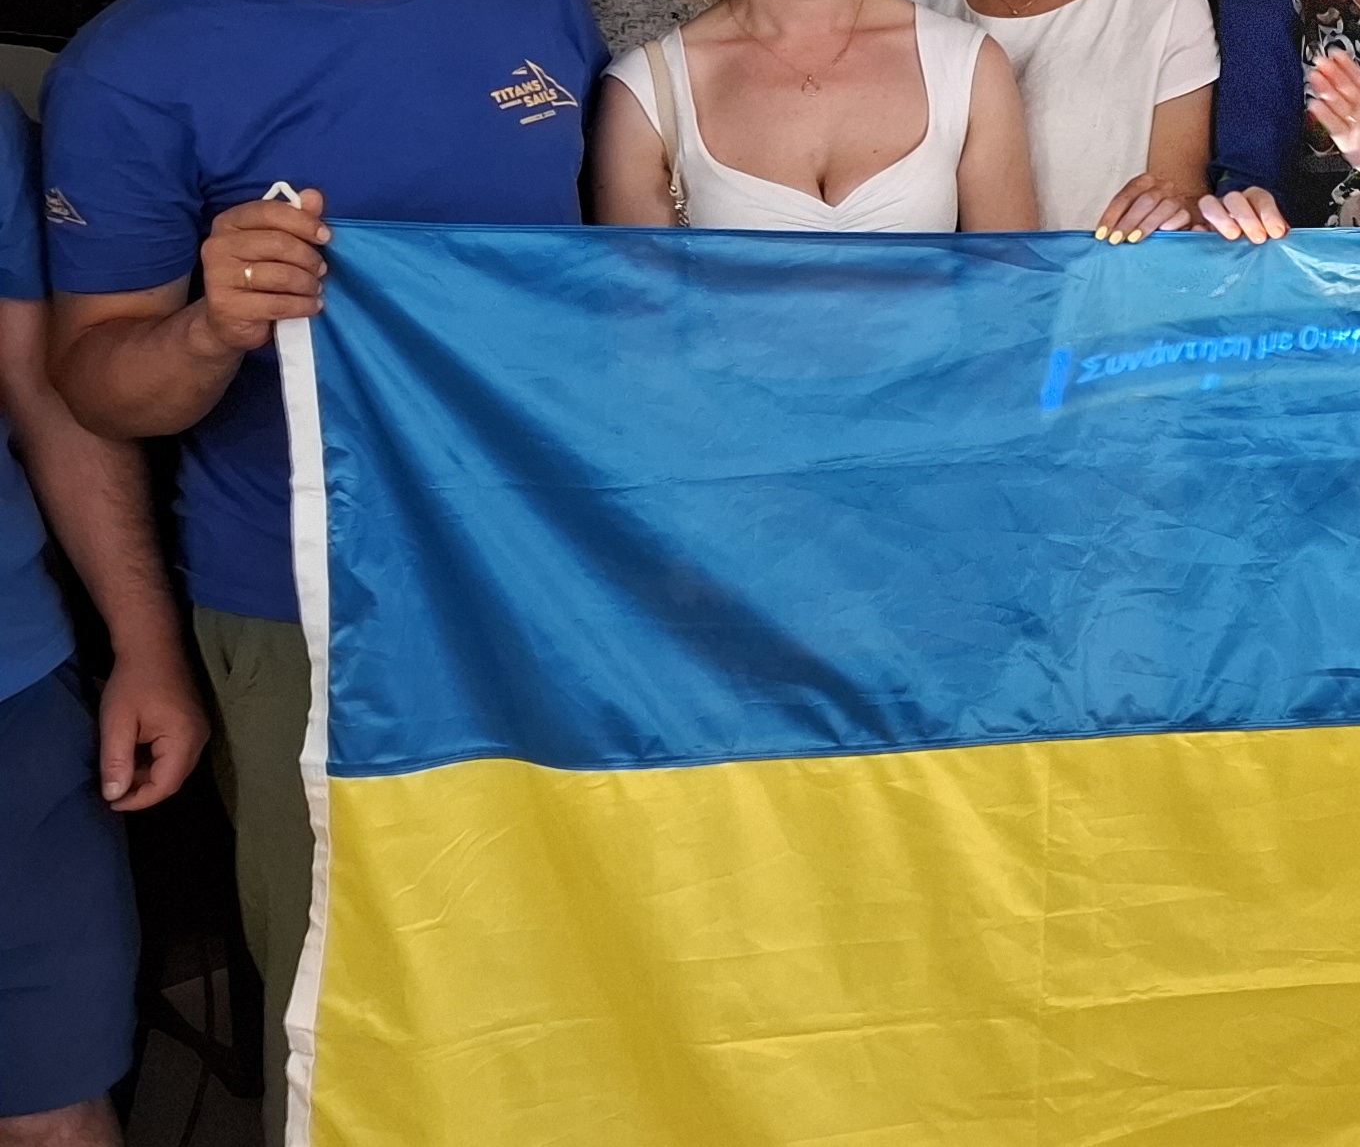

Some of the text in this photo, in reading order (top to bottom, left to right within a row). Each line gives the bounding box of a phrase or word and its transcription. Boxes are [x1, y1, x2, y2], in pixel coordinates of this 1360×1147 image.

[490, 79, 541, 103] TITANS
[522, 88, 558, 108] SAILS
[1075, 334, 1252, 384] Συνάντηση
[1255, 327, 1293, 360] με
